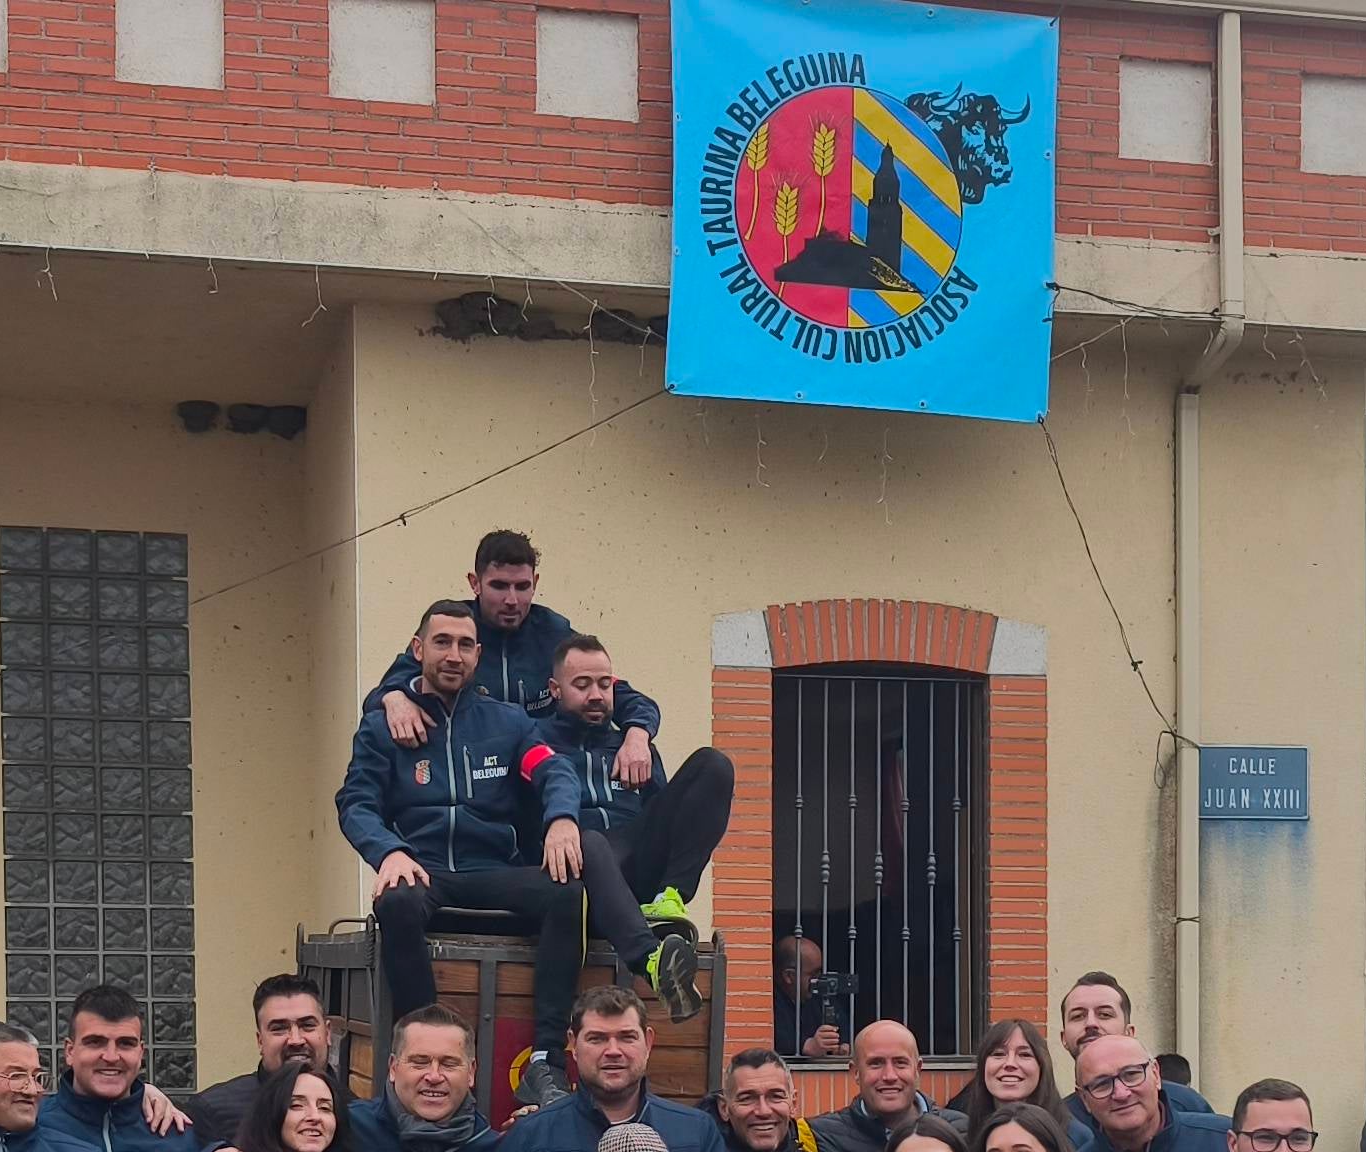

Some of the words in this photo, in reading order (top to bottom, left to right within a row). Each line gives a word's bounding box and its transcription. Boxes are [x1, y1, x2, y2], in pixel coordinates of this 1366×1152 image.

[726, 52, 866, 128] BELEGUINA
[700, 127, 744, 258] TAURINA
[719, 252, 838, 361] CULTURAL
[844, 266, 979, 363] ASOCIACION
[484, 755, 498, 767] ACT
[1204, 788, 1250, 809] JUAN
[1263, 788, 1300, 809] XXIII
[1229, 757, 1276, 775] CALLE
